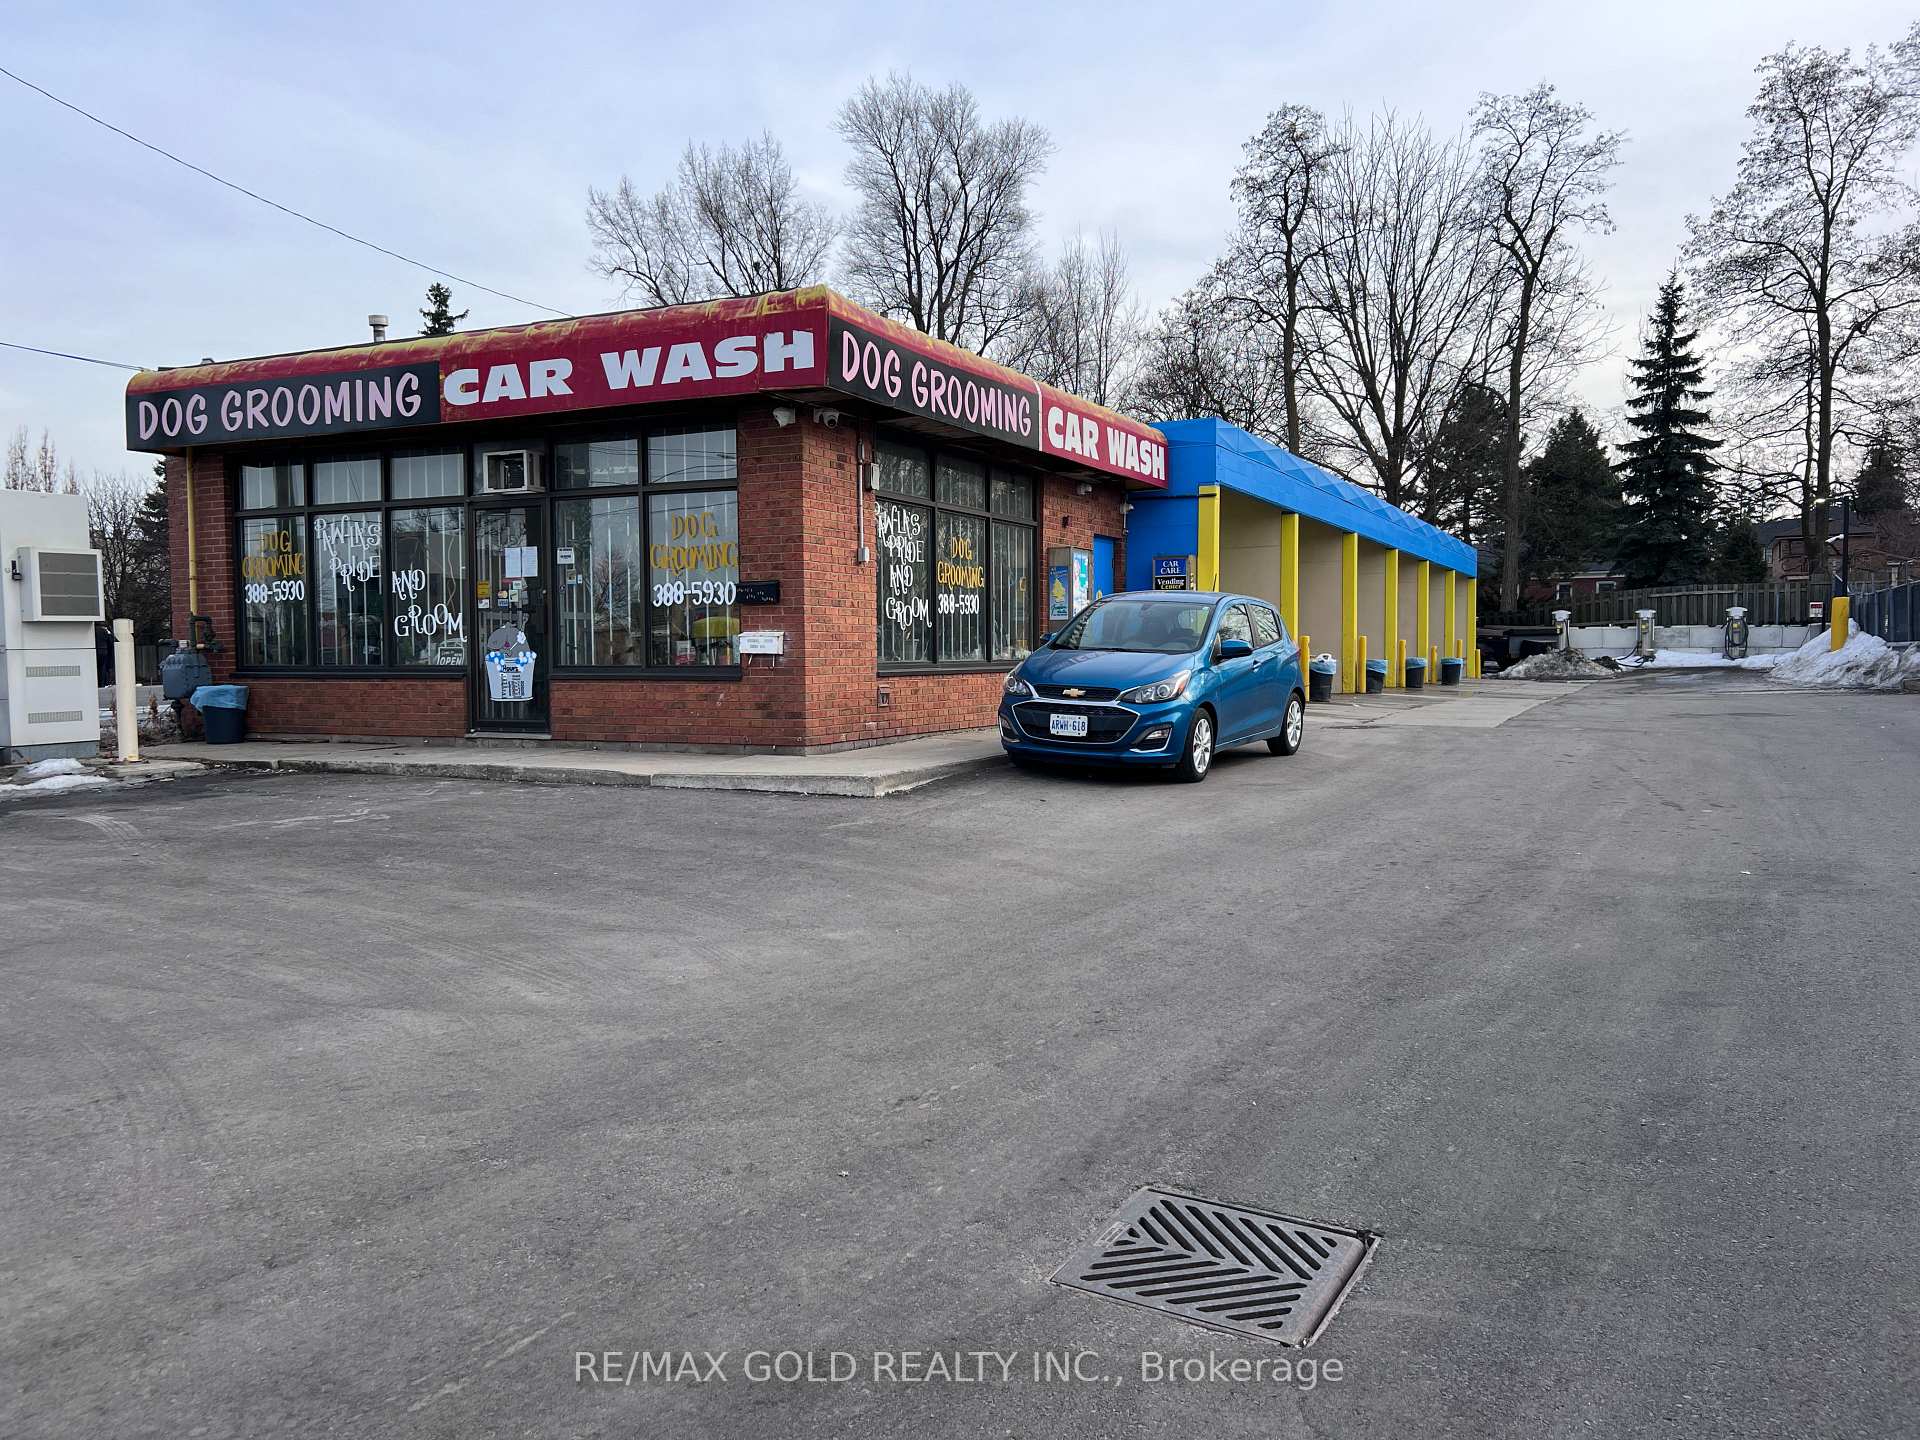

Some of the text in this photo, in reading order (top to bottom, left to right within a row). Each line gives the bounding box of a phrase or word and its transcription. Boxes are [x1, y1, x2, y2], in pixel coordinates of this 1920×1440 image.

[444, 330, 815, 406] CAR WASH
[840, 330, 1032, 437] DOG GROOMING
[138, 372, 422, 441] DOG GROOMING
[1048, 406, 1166, 481] CAR WASH
[671, 511, 719, 540] DOG
[649, 541, 739, 576] GROOMING
[887, 534, 925, 565] PRIDE
[951, 536, 972, 561] DOG
[1162, 560, 1179, 568] CAR
[329, 554, 382, 592] PRIDE
[391, 568, 427, 601] AND
[889, 565, 914, 595] AND
[937, 560, 985, 591] GROOMING
[1157, 577, 1185, 586] Vending
[1160, 567, 1182, 575] CARE
[244, 579, 305, 604] 388-5930
[652, 581, 737, 608] 388-5930
[937, 594, 980, 615] 388-5930
[394, 603, 468, 643] GROOM
[885, 596, 933, 631] GROOM
